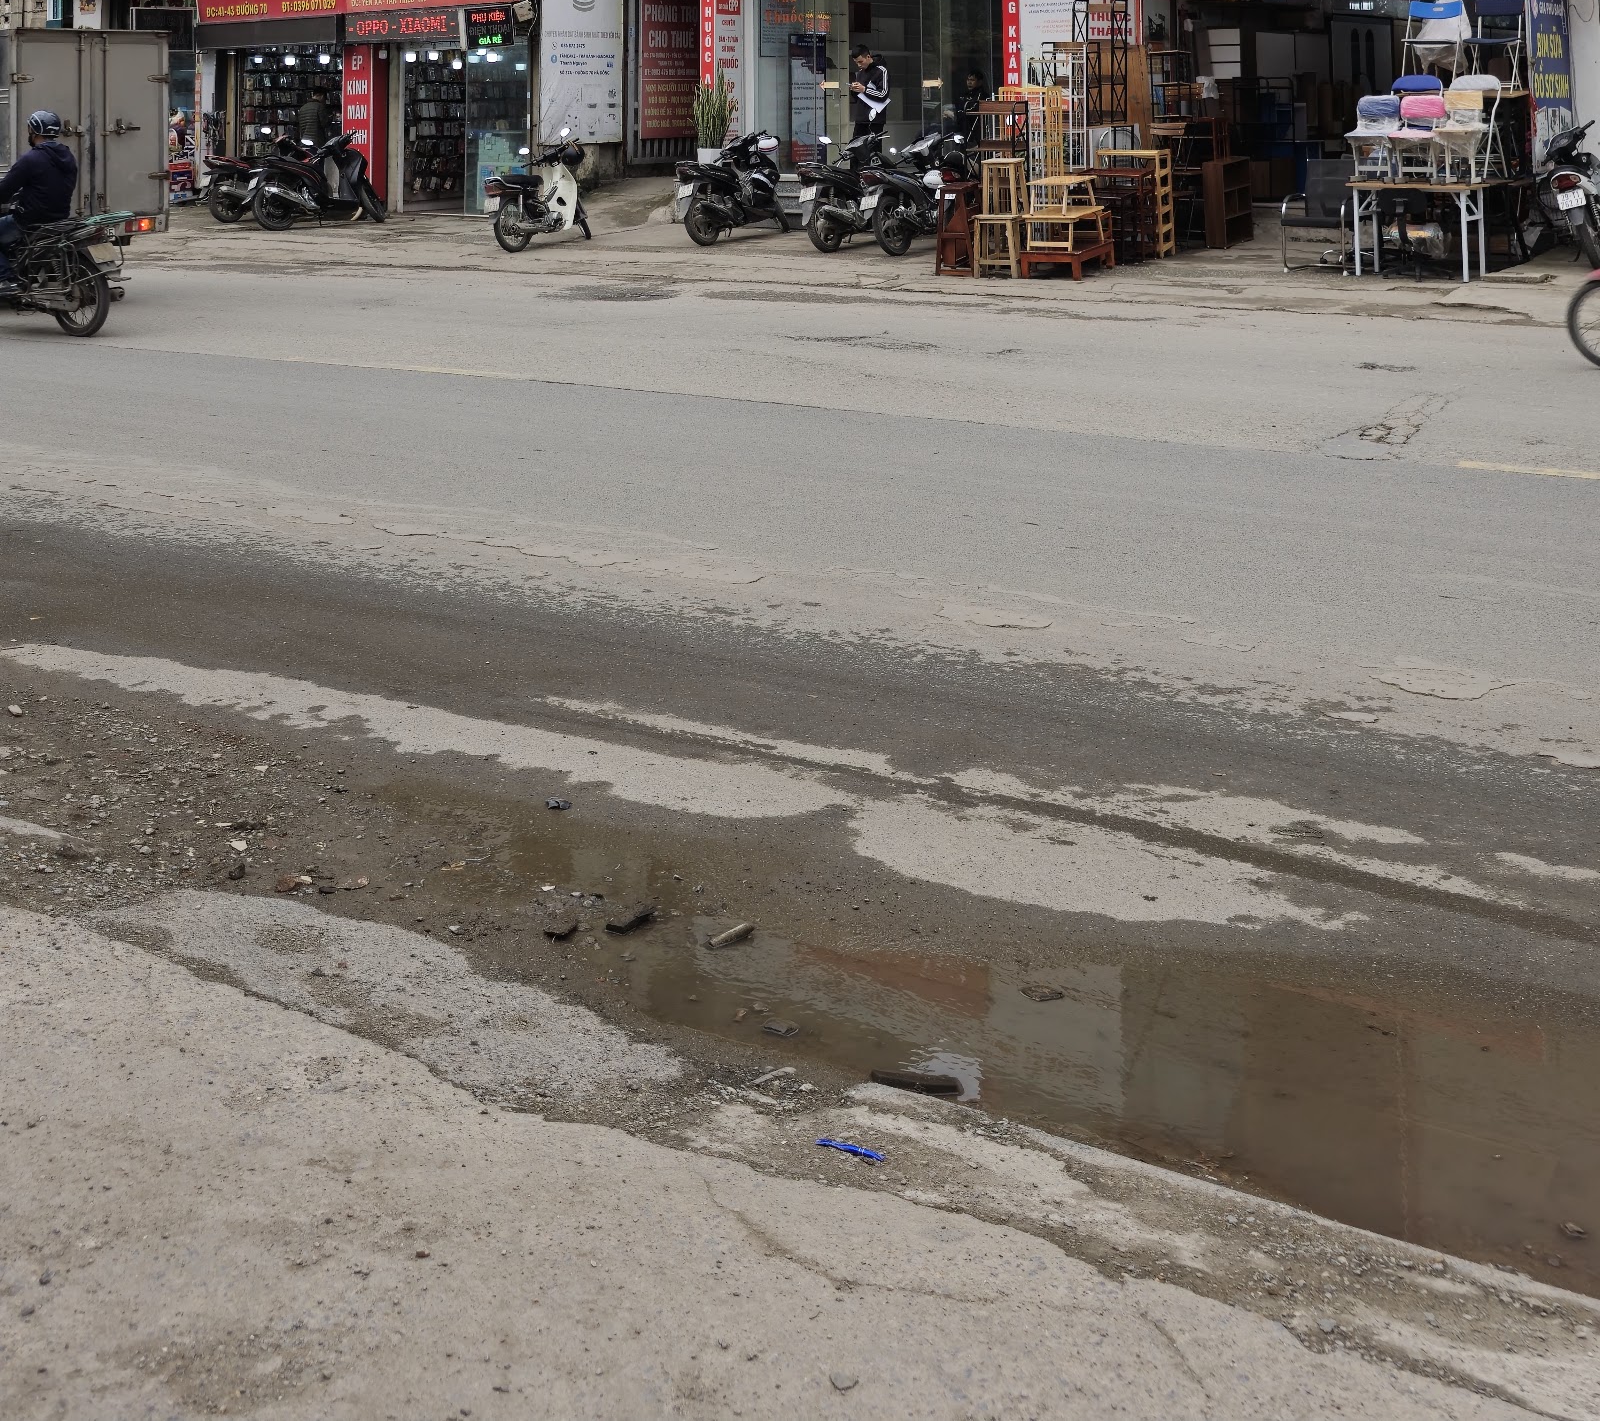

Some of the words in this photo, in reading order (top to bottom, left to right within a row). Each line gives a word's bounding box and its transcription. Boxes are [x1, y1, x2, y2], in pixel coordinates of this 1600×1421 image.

[644, 0, 678, 23] PHÒNG
[680, 5, 698, 27] TRỌ
[728, 0, 739, 12] GPP
[764, 5, 805, 25] Thuốc
[356, 19, 389, 36] OPPO
[399, 15, 448, 34] XIAOMI
[471, 12, 487, 24] PHỤ
[648, 29, 668, 48] CHO
[671, 27, 695, 49] THUÊ
[351, 52, 363, 71] ÉP
[719, 55, 739, 69] THUỐC
[1007, 25, 1019, 85] KHÁM
[347, 77, 368, 96] KÍNH
[1555, 73, 1570, 99] SINH
[347, 101, 367, 120] MÀN
